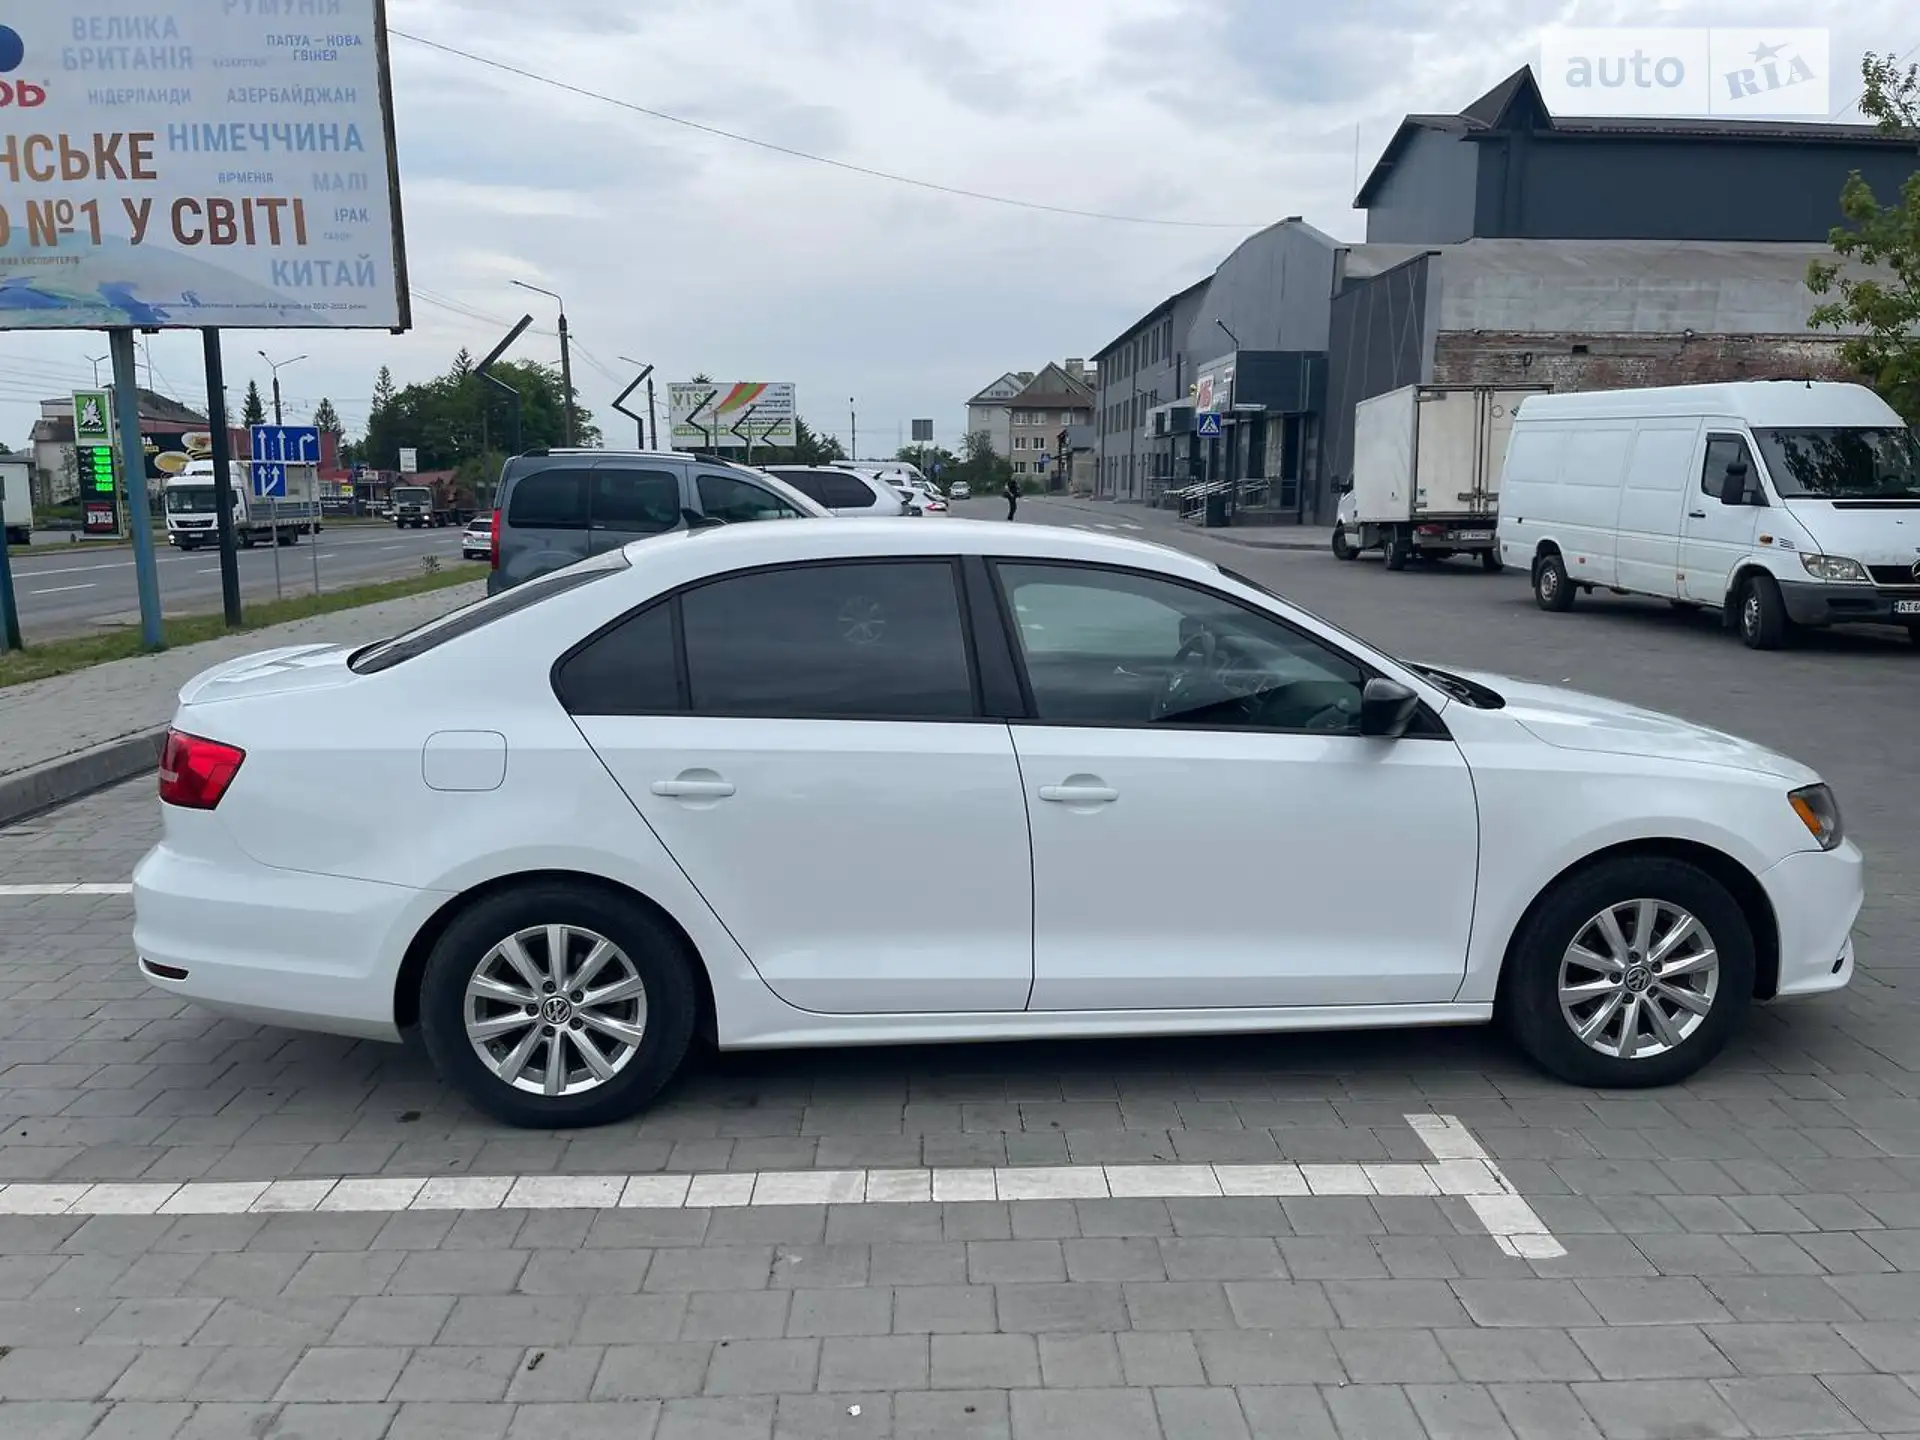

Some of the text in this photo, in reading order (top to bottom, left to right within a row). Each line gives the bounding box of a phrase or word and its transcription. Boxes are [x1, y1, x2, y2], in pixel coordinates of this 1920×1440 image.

[72, 15, 180, 41] ВЕЛИКА
[266, 34, 310, 46] ПАПУА
[326, 35, 362, 46] НОВА
[61, 46, 194, 71] БРИТАНІЯ
[293, 49, 338, 61] ГВІНЕЯ
[88, 88, 192, 105] НІДЕРЛАНДИ
[227, 84, 357, 106] АЗЕРБАЙДЖАН
[168, 123, 365, 152] НІМЕЧЧИНА
[312, 172, 368, 192] МАЛІ
[171, 197, 308, 246] СВІТІ
[335, 207, 371, 223] ІРАК
[271, 253, 377, 288] КИТАЙ
